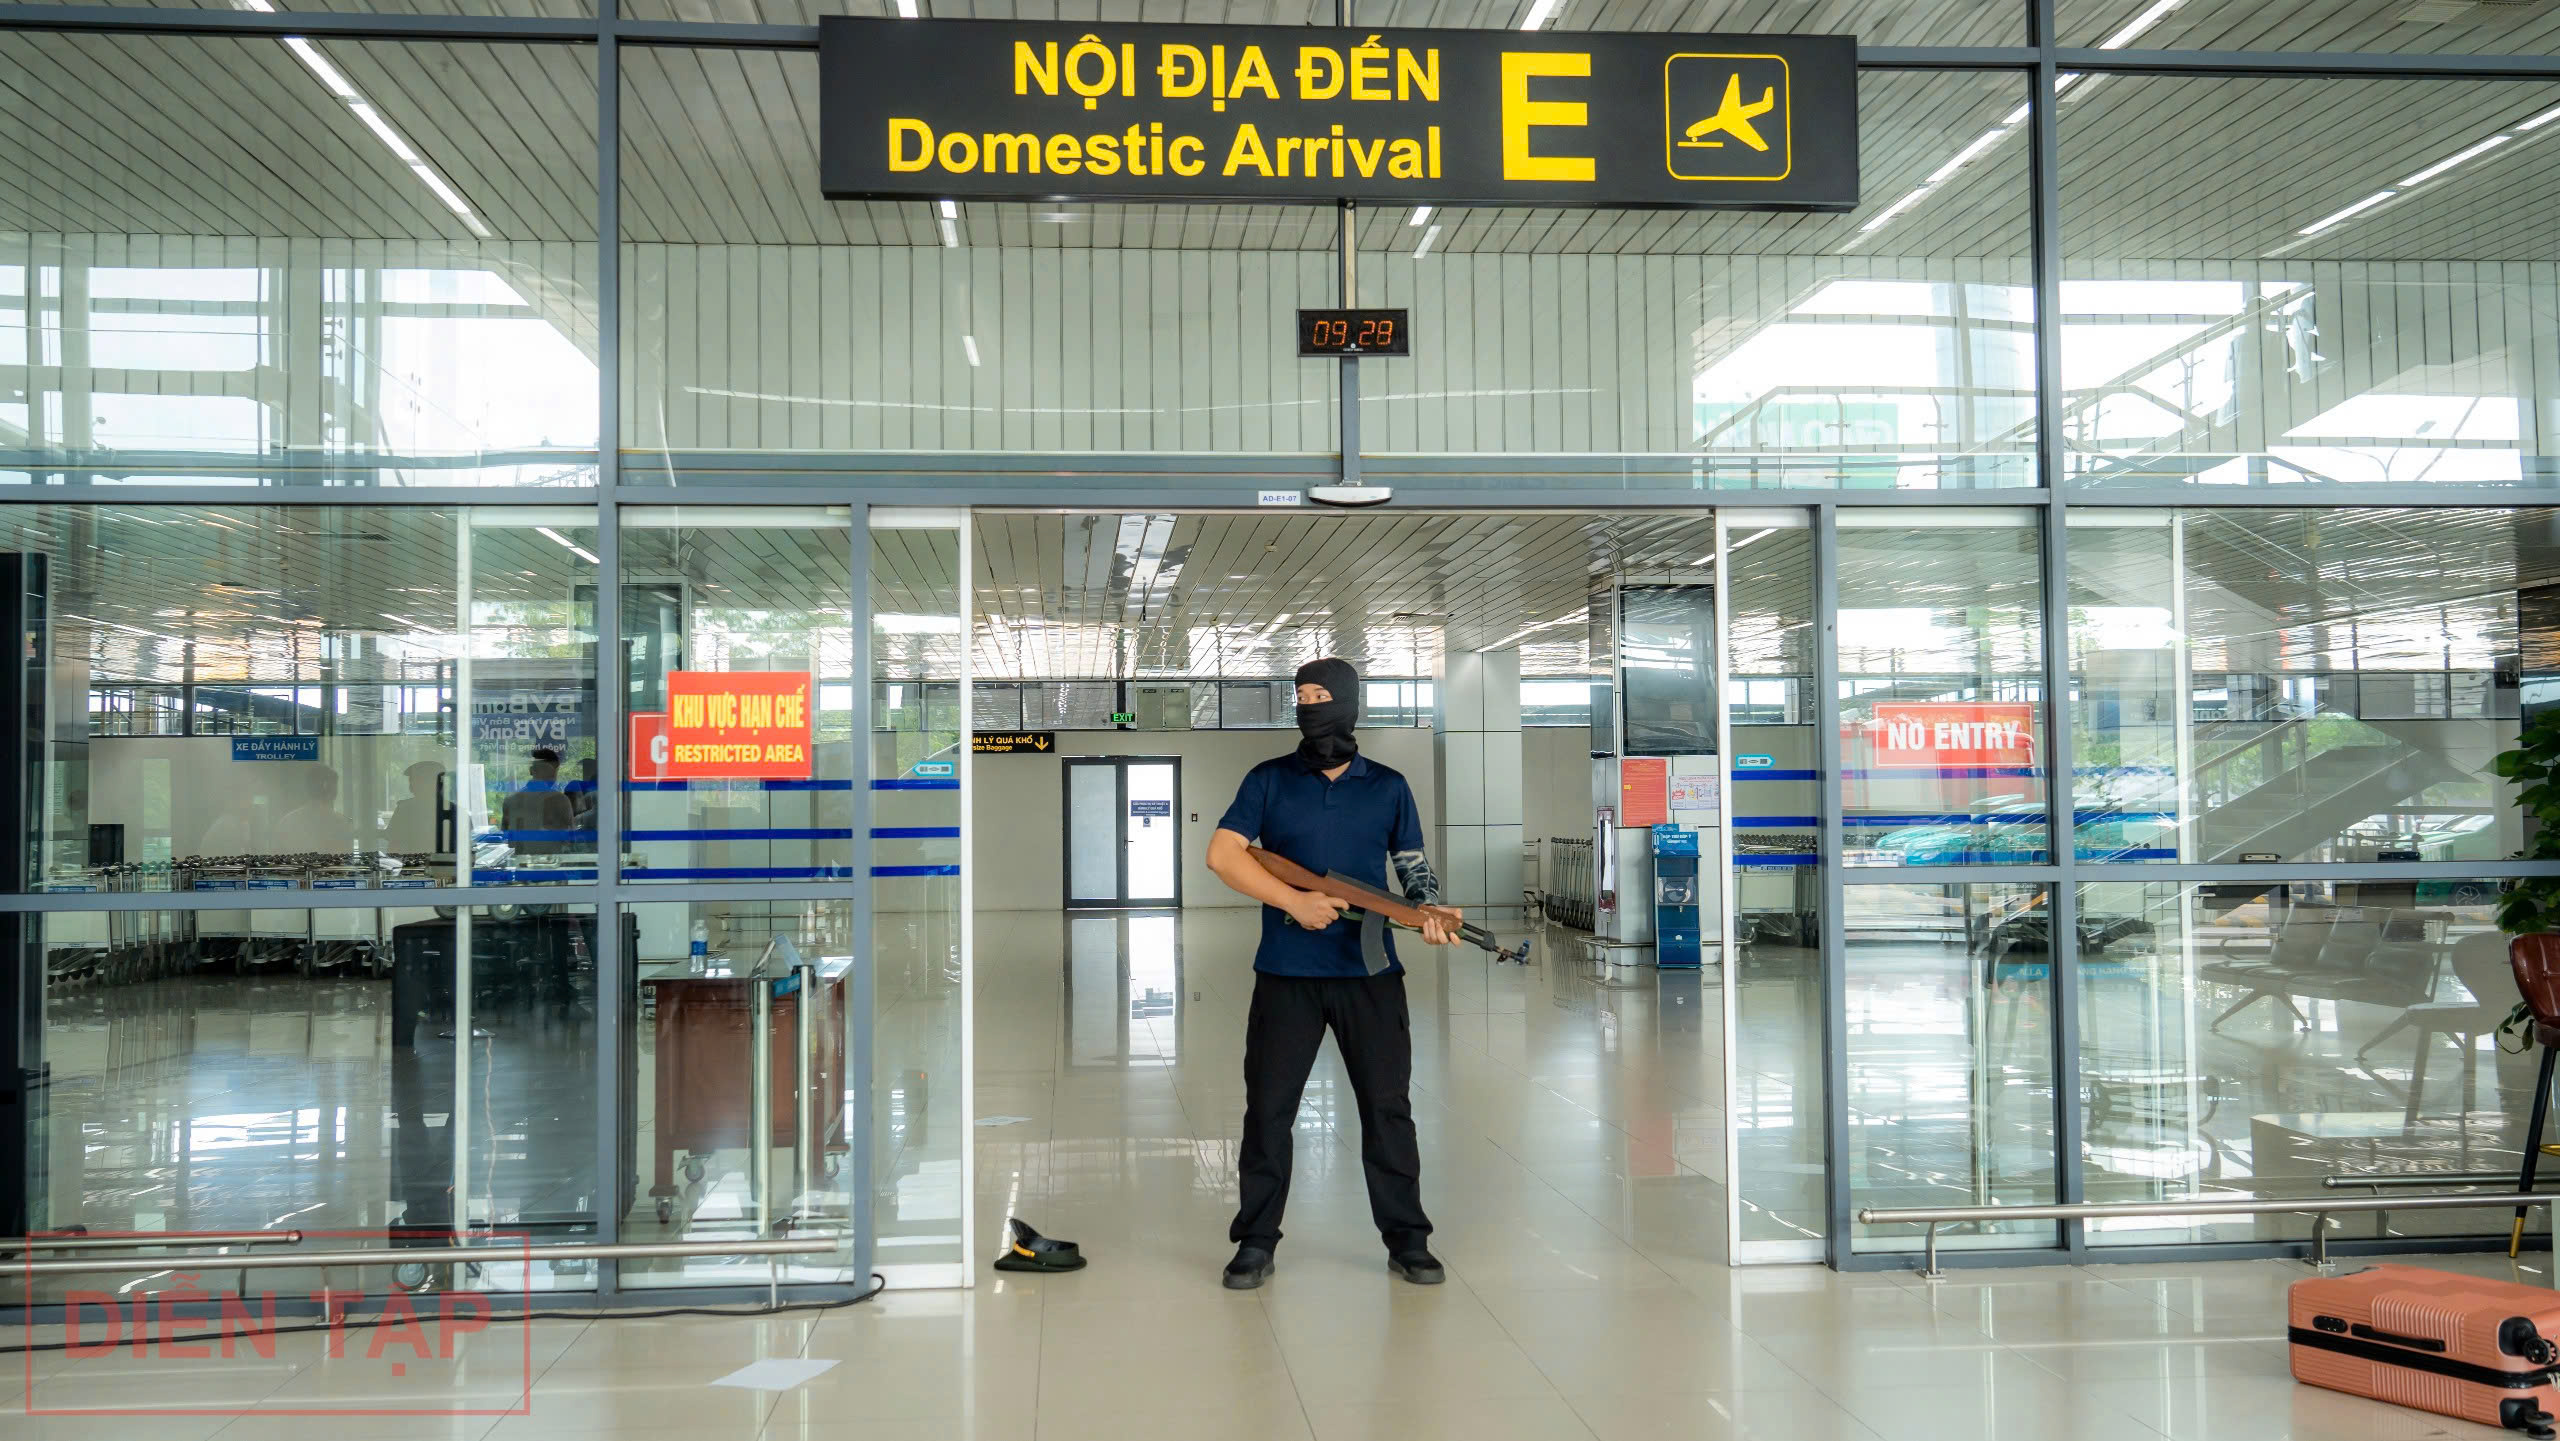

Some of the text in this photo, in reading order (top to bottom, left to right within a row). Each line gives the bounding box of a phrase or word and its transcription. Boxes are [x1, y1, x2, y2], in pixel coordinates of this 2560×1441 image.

[1014, 33, 1440, 112] NỘI ĐỊA ĐẾN
[1500, 52, 1597, 181] E
[888, 117, 1442, 179] Domestic Arrival
[673, 684, 806, 736] KHU VỰC HẠN CHẾ
[1113, 713, 1134, 722] EXIT
[236, 742, 249, 751] XE
[274, 741, 301, 751] HÀNH
[302, 741, 315, 751] LÝ
[675, 744, 804, 763] RESTRICTED AREA
[1887, 721, 2020, 751] NO ENTRY
